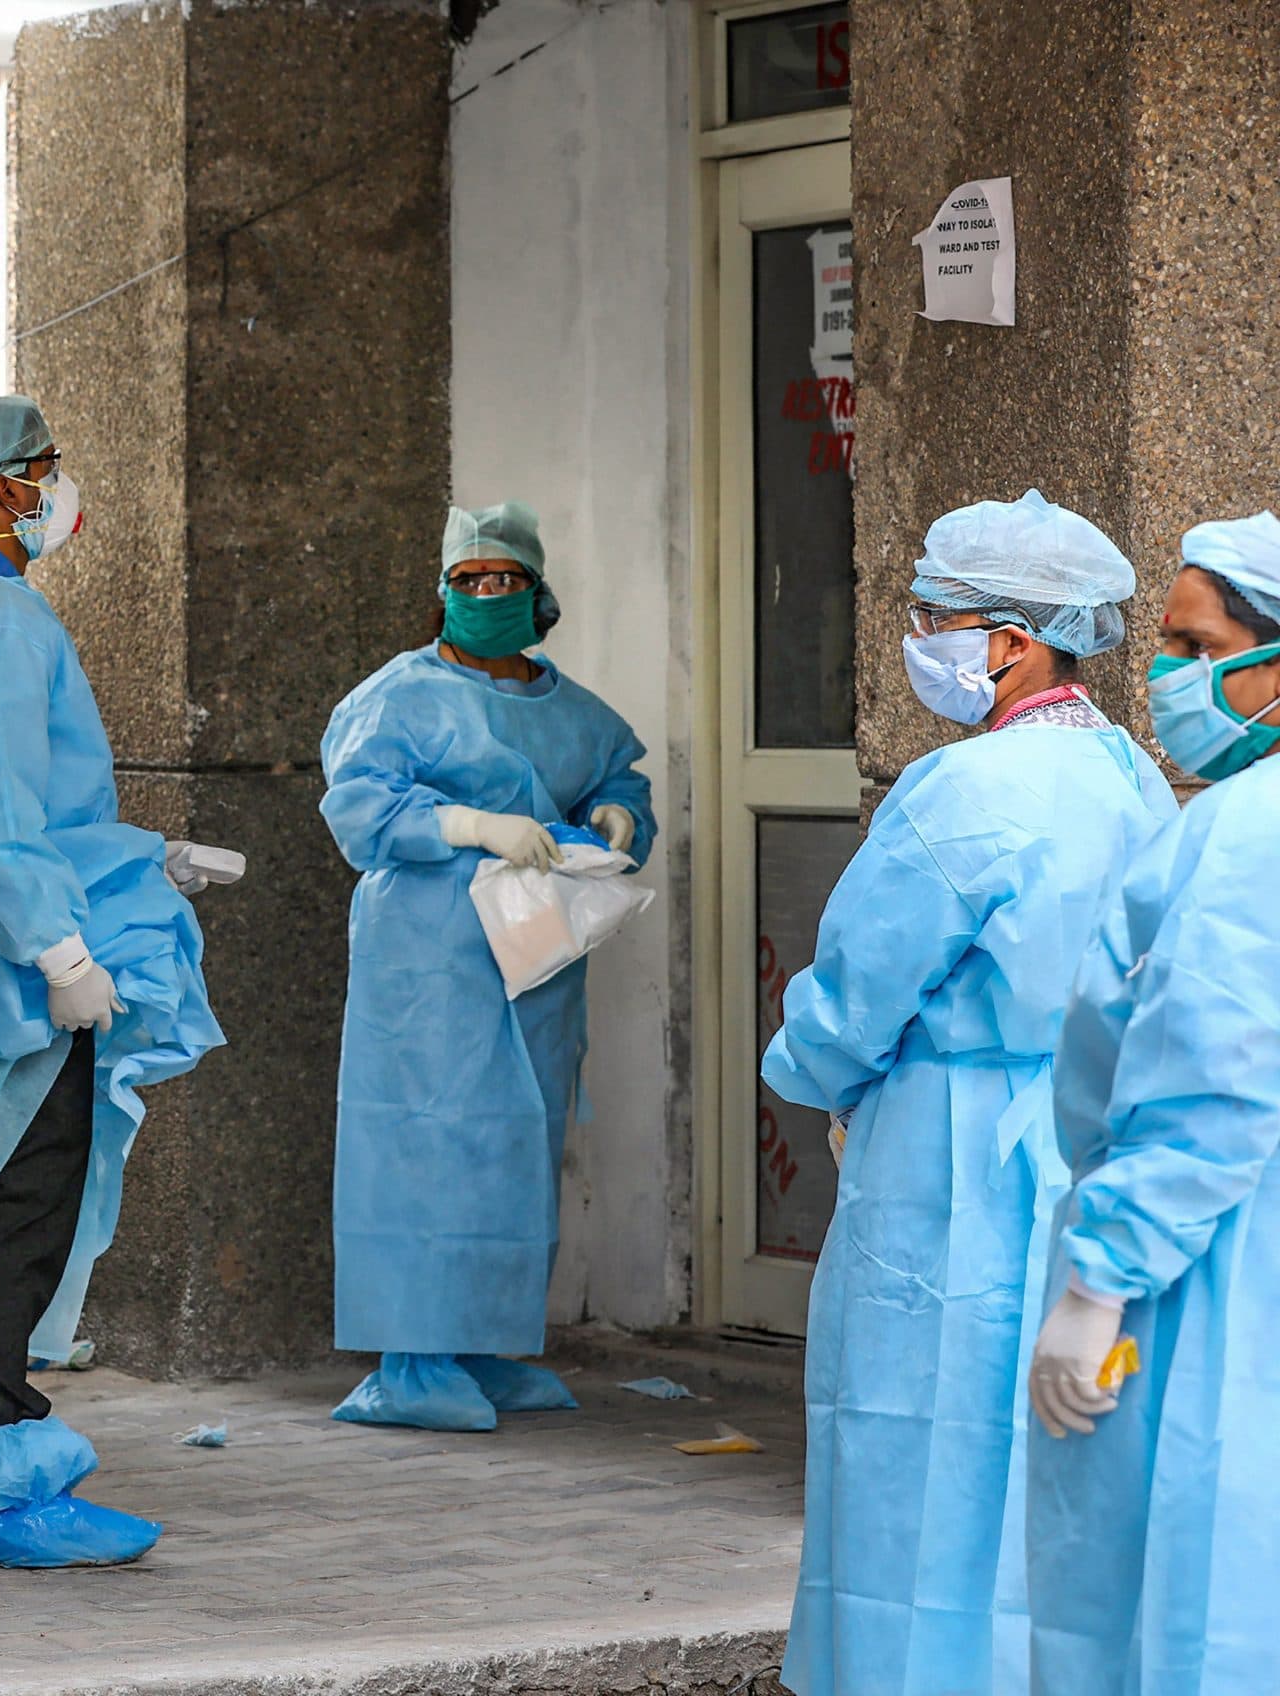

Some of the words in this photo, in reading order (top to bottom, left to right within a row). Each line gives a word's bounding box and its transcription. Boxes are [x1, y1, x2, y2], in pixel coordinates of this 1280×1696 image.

[959, 220, 969, 231] TO
[939, 243, 961, 254] WARD
[963, 242, 980, 252] AND
[981, 240, 1000, 251] TEST
[938, 264, 973, 275] FACILITY
